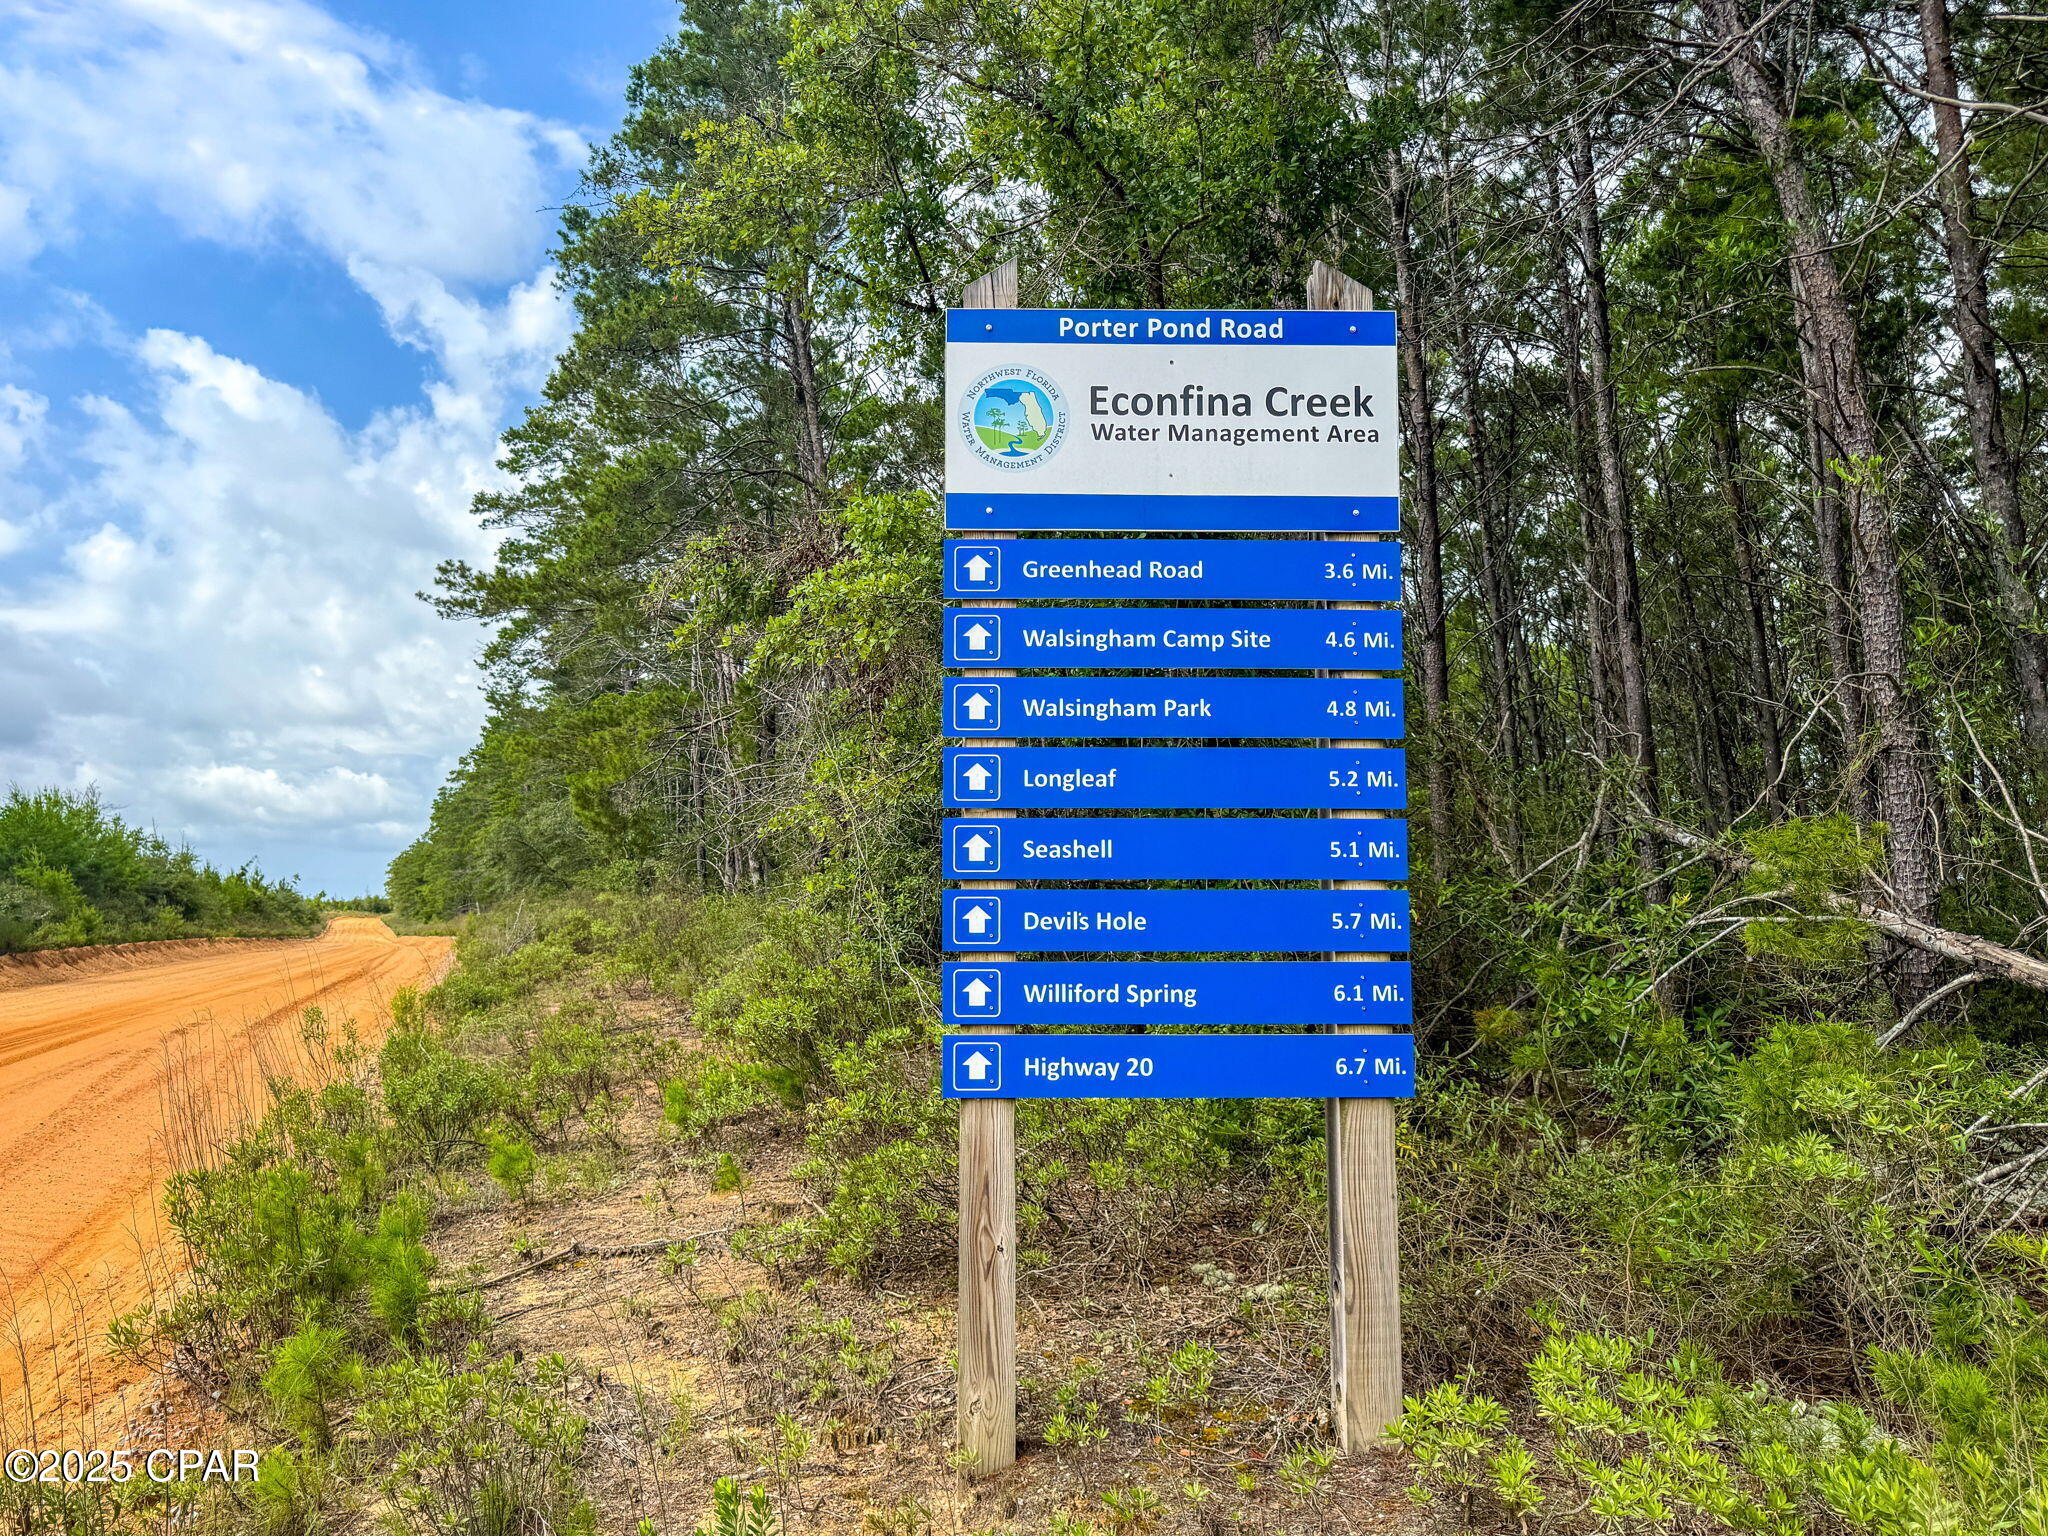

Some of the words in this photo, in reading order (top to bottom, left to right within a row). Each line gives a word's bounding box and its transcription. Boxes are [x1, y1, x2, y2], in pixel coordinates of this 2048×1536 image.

[1060, 318, 1138, 337] Porter
[1148, 318, 1210, 338] Pond
[1221, 318, 1282, 338] Road
[967, 369, 1021, 399] NORTHWEST
[1026, 370, 1059, 401] FLORIDA
[1091, 385, 1251, 416] Econfina
[1266, 386, 1374, 417] Creek
[962, 412, 975, 446] WATER
[975, 446, 1043, 469] MANAGEMENT
[1044, 412, 1065, 455] DISTRICT
[1091, 424, 1160, 441] Water
[1169, 425, 1319, 446] Management
[1327, 425, 1378, 442] Area
[1023, 560, 1141, 578] Greenhead
[1150, 561, 1202, 578] Road
[1325, 563, 1353, 579] 3.6
[1363, 564, 1393, 579] Mi.
[1023, 629, 1155, 651] Walsingham
[1164, 630, 1224, 651] Camp
[1232, 630, 1270, 647] Site
[1326, 632, 1355, 647] 4.6
[1364, 632, 1394, 648] Mi.
[1023, 699, 1156, 721] Walsingham
[1165, 699, 1211, 716] Park
[1327, 701, 1356, 716] 4.8
[1366, 701, 1395, 717] Mi.
[1024, 769, 1116, 791] Longleaf
[1330, 771, 1358, 786] 5.2
[1368, 771, 1398, 787] Mi.
[1023, 840, 1112, 858] Seashell
[1331, 842, 1359, 857] 5.1
[1369, 842, 1399, 857] Mi.
[1097, 912, 1146, 930] Hole
[1333, 913, 1361, 929] 5.7
[1371, 913, 1401, 929] Mi.
[1024, 984, 1119, 1002] Williford
[1127, 984, 1196, 1007] Spring
[1334, 985, 1363, 1001] 6.1
[1373, 985, 1404, 1001] Mi.
[1025, 1057, 1119, 1080] Highway
[1127, 1058, 1153, 1076] 20
[1336, 1058, 1365, 1075] 6.7
[1375, 1058, 1406, 1074] Mi.
